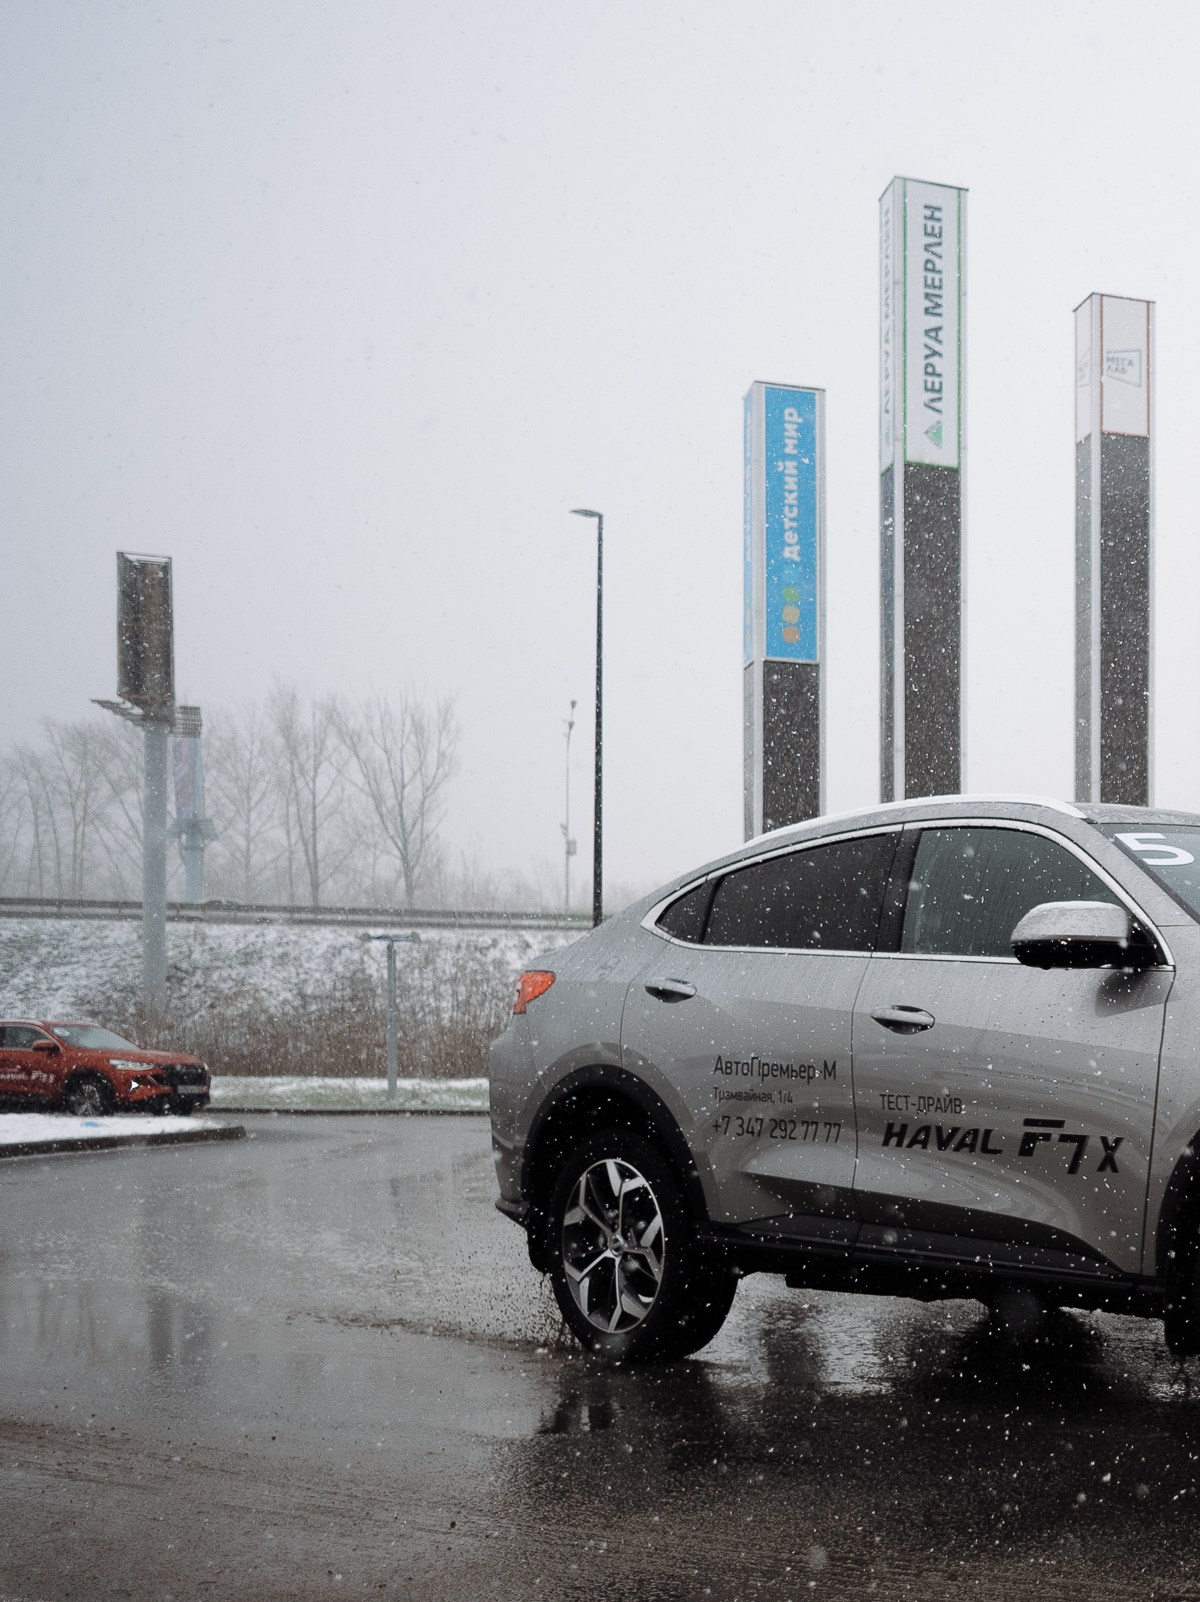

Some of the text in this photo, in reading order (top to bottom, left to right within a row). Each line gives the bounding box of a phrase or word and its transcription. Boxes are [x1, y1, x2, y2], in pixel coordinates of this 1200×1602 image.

[923, 203, 943, 415] ЛЕРУА МЕРЛЕН
[777, 407, 804, 562] детский мир
[1114, 832, 1195, 866] 5
[714, 1055, 837, 1085] АвтоПремьер-М
[713, 1087, 793, 1104] Трамвайная, 1/4
[879, 1093, 963, 1115] ТЕСТ-ДРАЙВ
[712, 1115, 841, 1143] +7 347 292 77 77
[882, 1122, 1003, 1155] HAVAL
